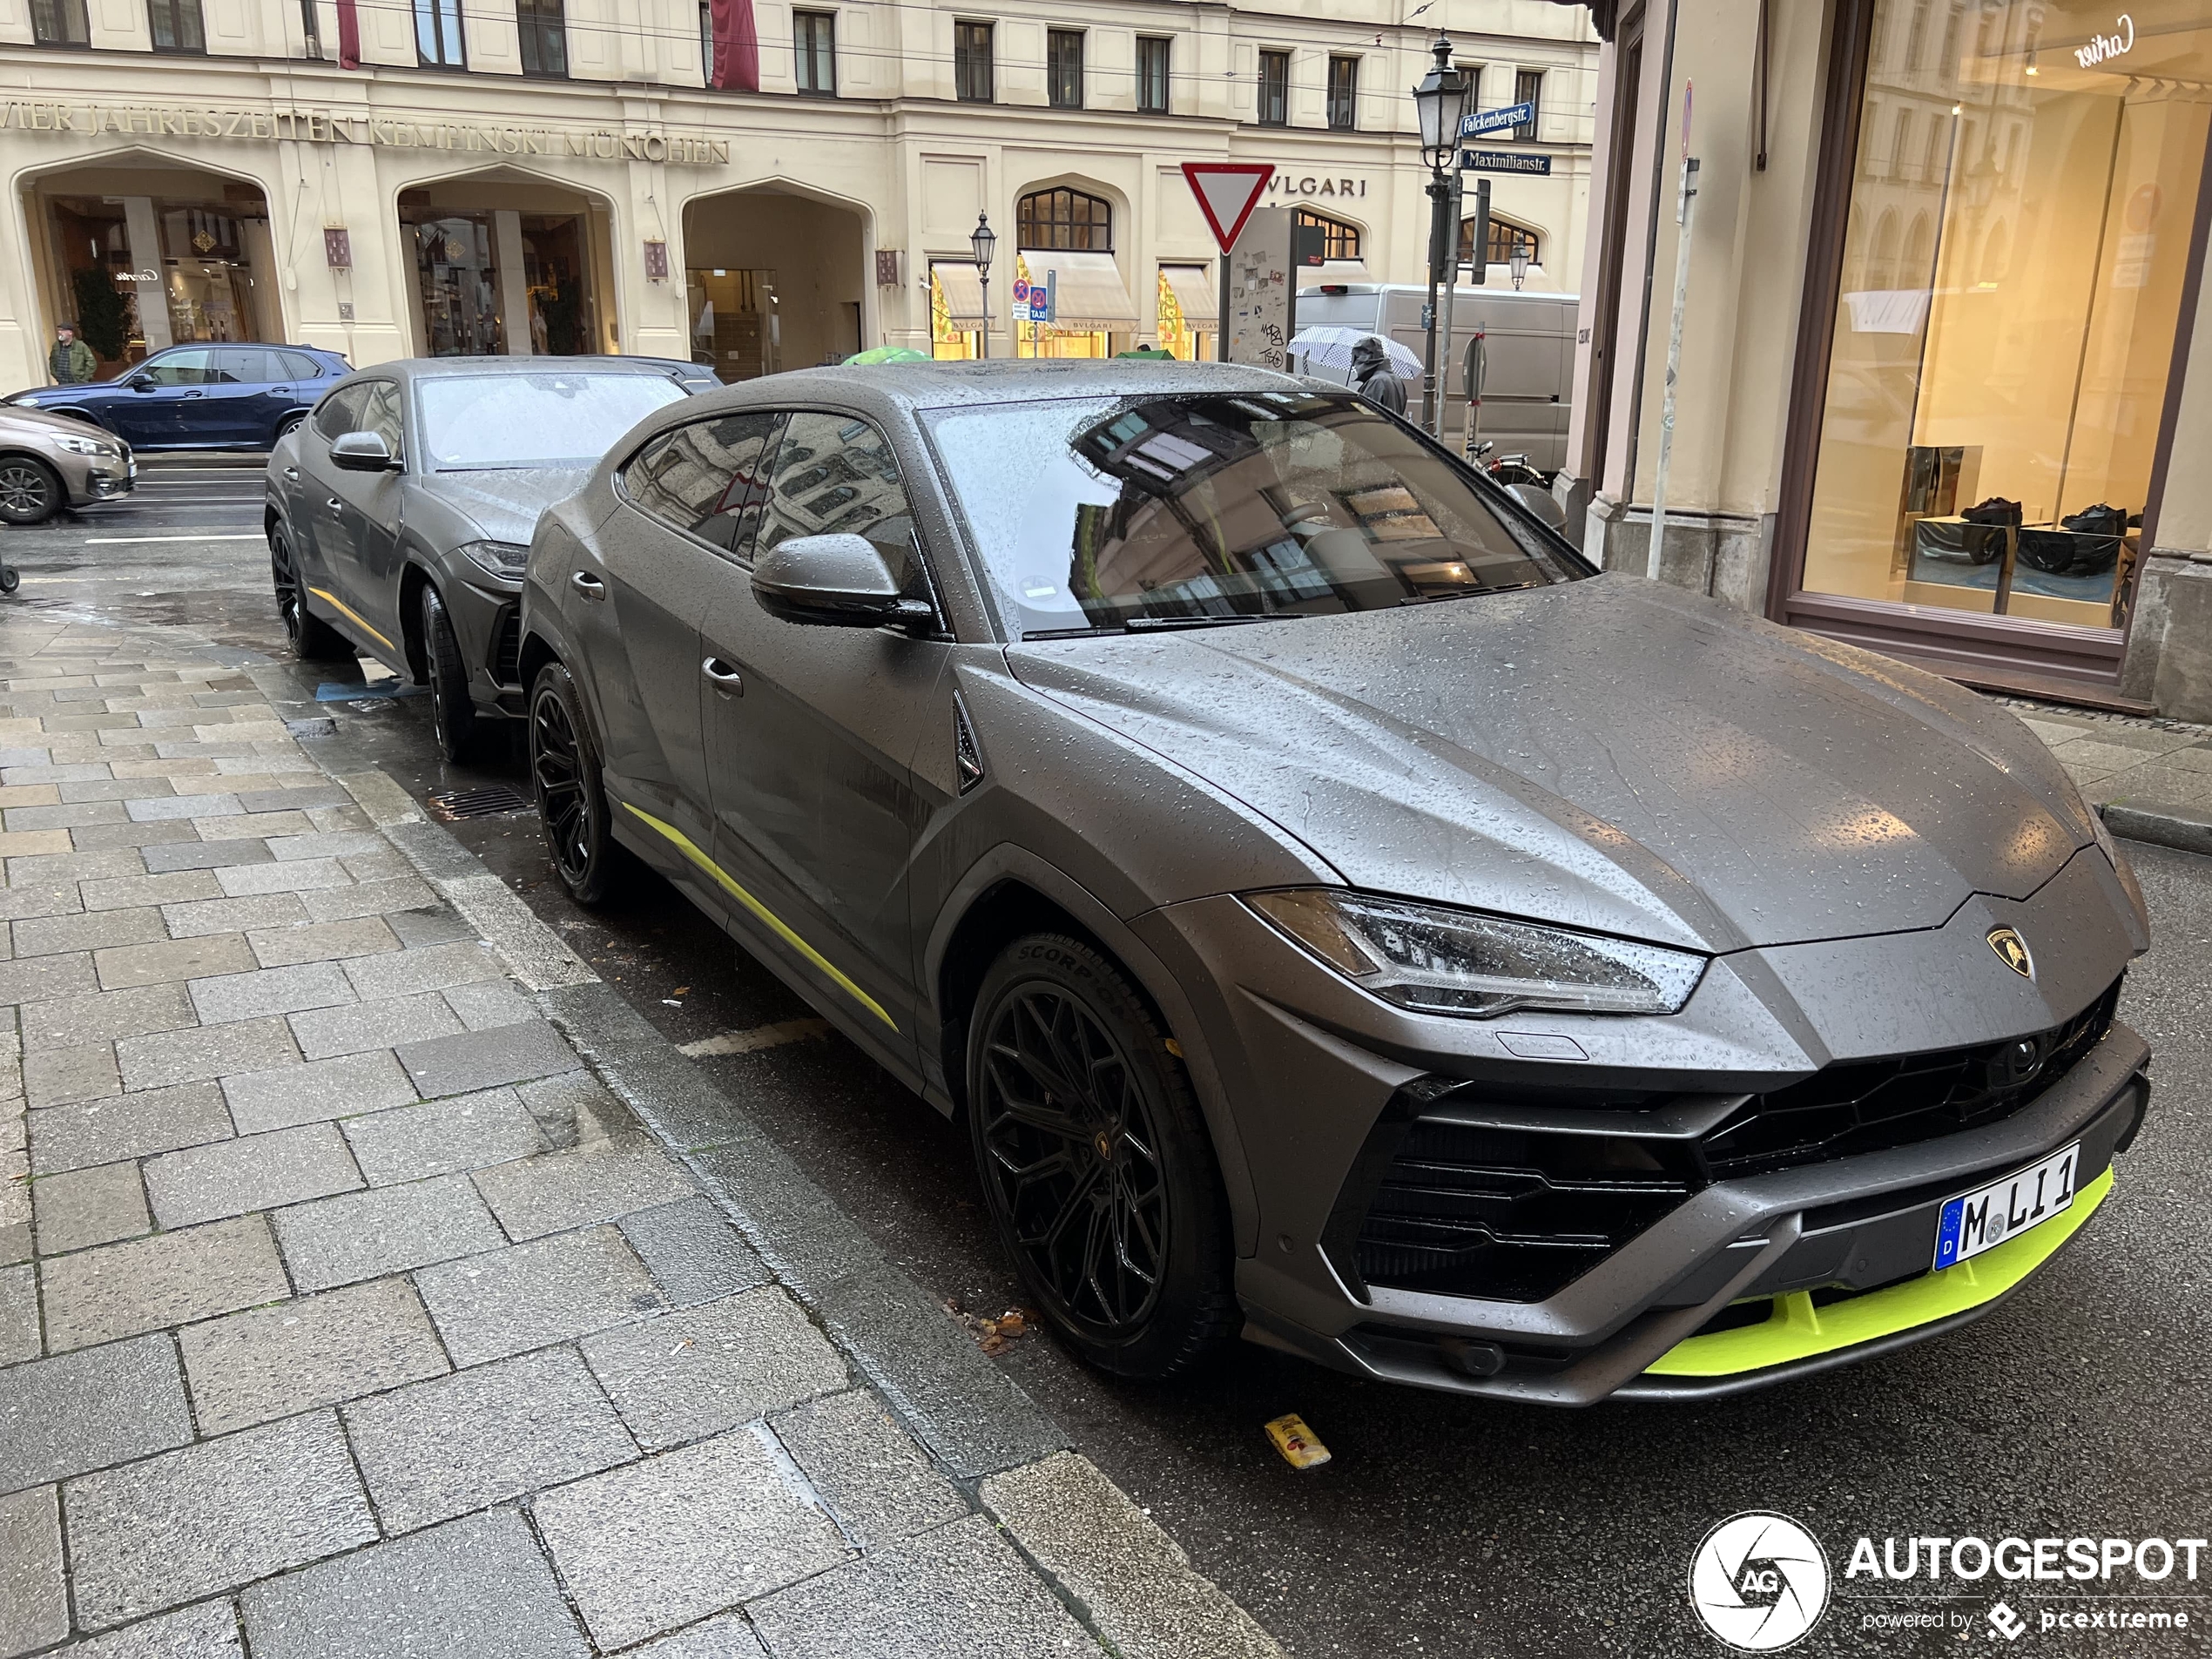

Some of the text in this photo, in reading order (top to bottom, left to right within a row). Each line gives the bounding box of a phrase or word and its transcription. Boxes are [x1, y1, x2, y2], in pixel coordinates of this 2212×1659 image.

[1463, 108, 1527, 133] Falckenbergstr.
[87, 105, 354, 144] JAHRESZEITEN
[367, 118, 551, 154] KEMPINSKI
[565, 129, 730, 165] MÜNCHEN
[1468, 152, 1545, 172] Maximilianstr.
[1268, 176, 1366, 197] VLGARI
[1031, 309, 1046, 319] TAXI
[1943, 1239, 1952, 1256] D
[1961, 1195, 1990, 1252] M
